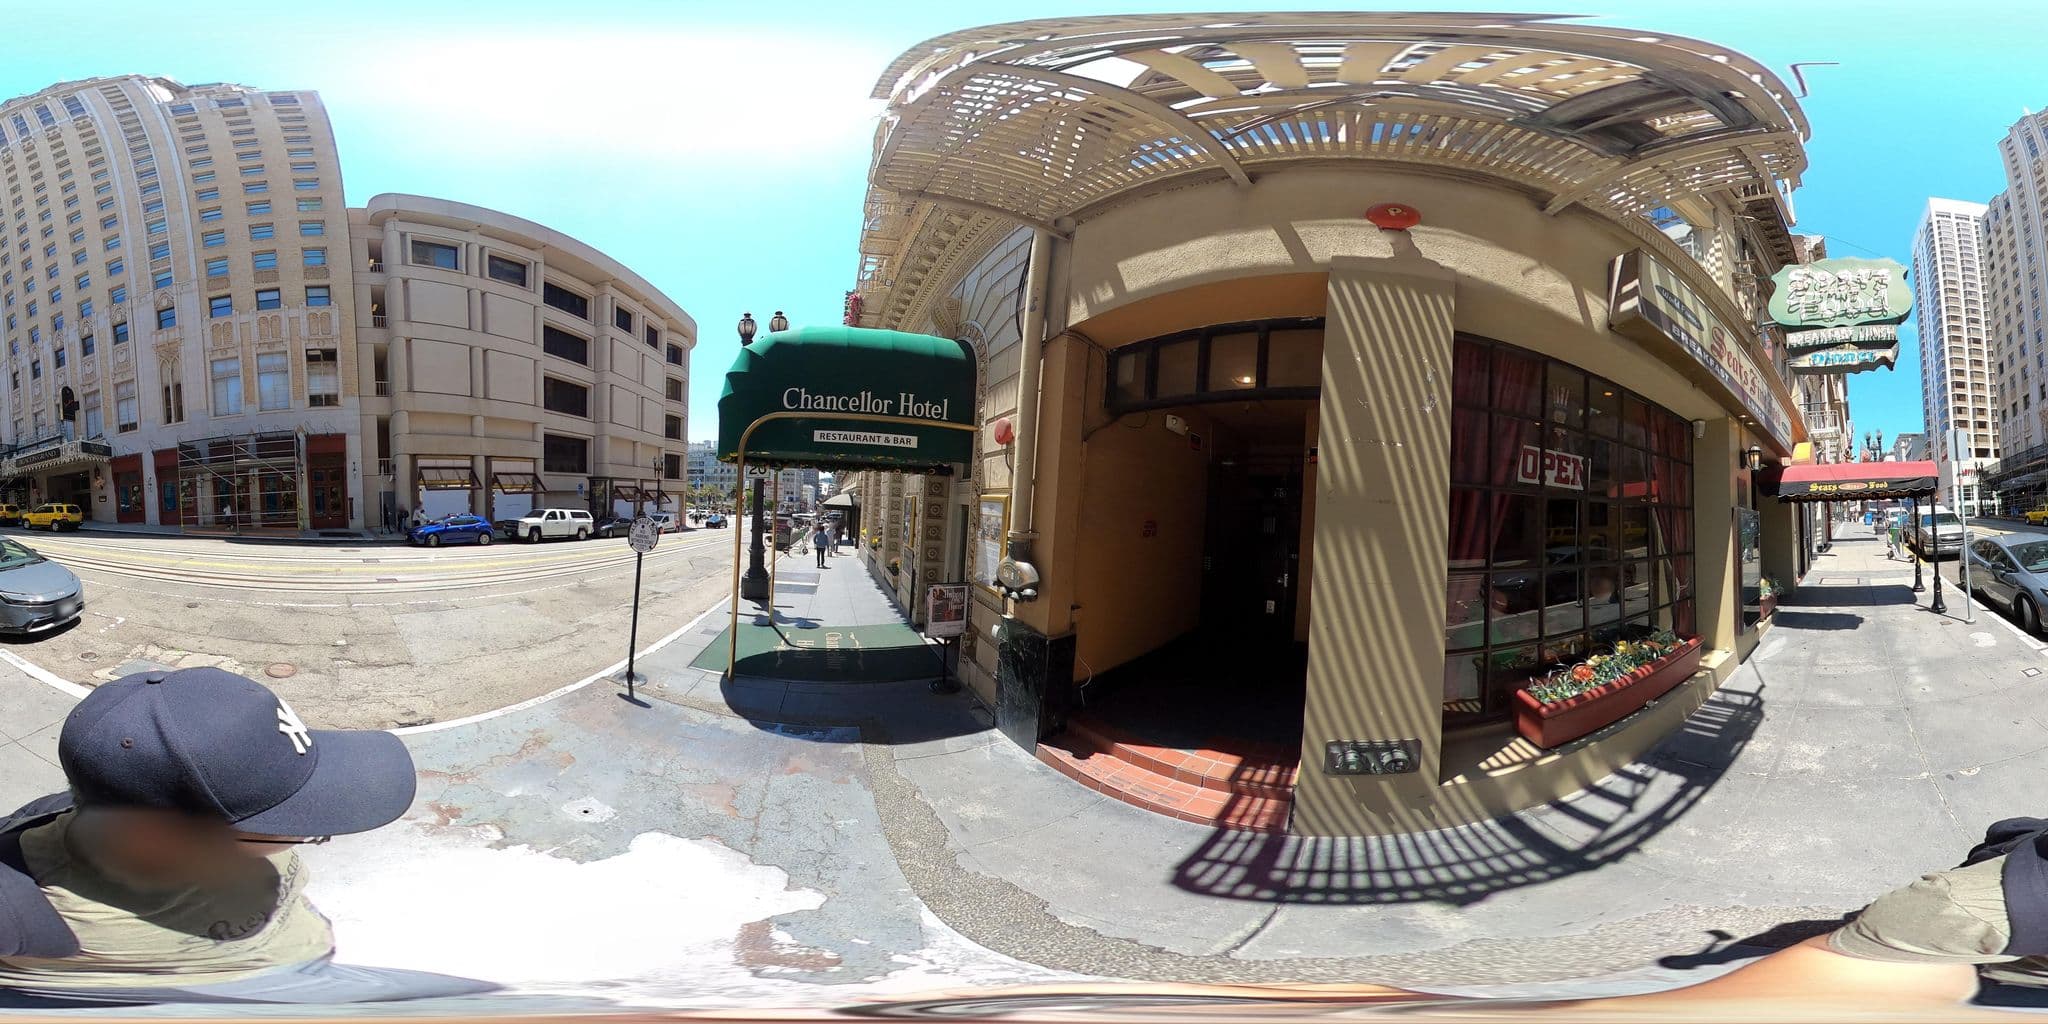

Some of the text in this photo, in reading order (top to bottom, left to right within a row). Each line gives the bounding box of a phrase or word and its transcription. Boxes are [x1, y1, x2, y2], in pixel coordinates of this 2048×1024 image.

[1671, 324, 1730, 383] BREAKFAST
[1711, 327, 1749, 386] Sears
[783, 387, 949, 421] Chancellor Hotel
[819, 432, 912, 446] RESTAURANT & BAR
[1522, 447, 1583, 486] OPEN
[1809, 483, 1838, 492] Sears
[1867, 481, 1888, 489] Food
